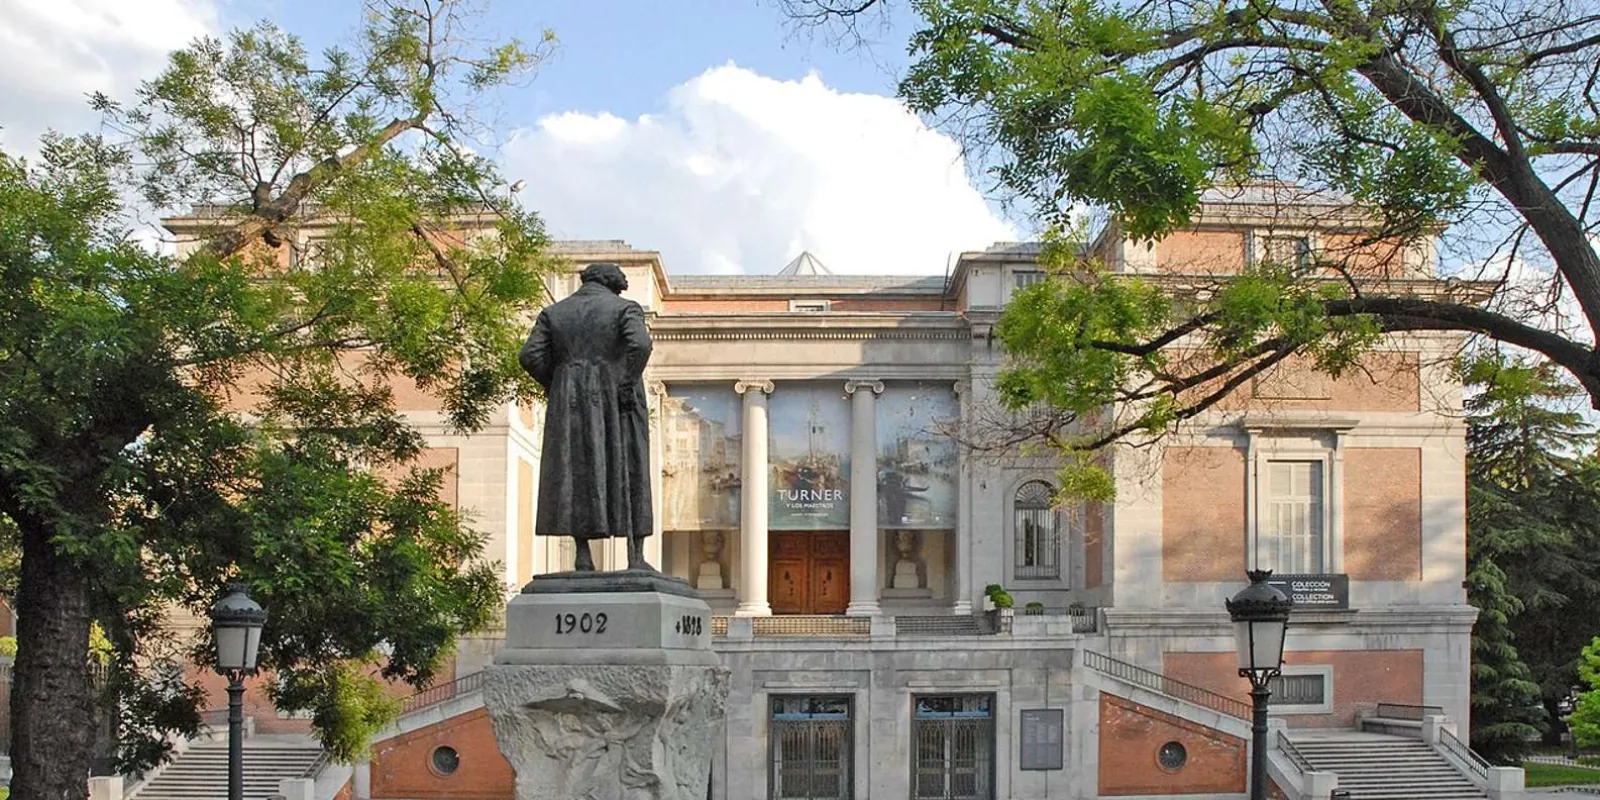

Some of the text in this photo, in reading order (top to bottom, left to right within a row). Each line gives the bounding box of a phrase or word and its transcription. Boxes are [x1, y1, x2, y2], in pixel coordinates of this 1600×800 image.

[776, 489, 843, 501] TURNER
[1291, 580, 1331, 588] COLECCIÓN
[555, 612, 608, 635] 1902
